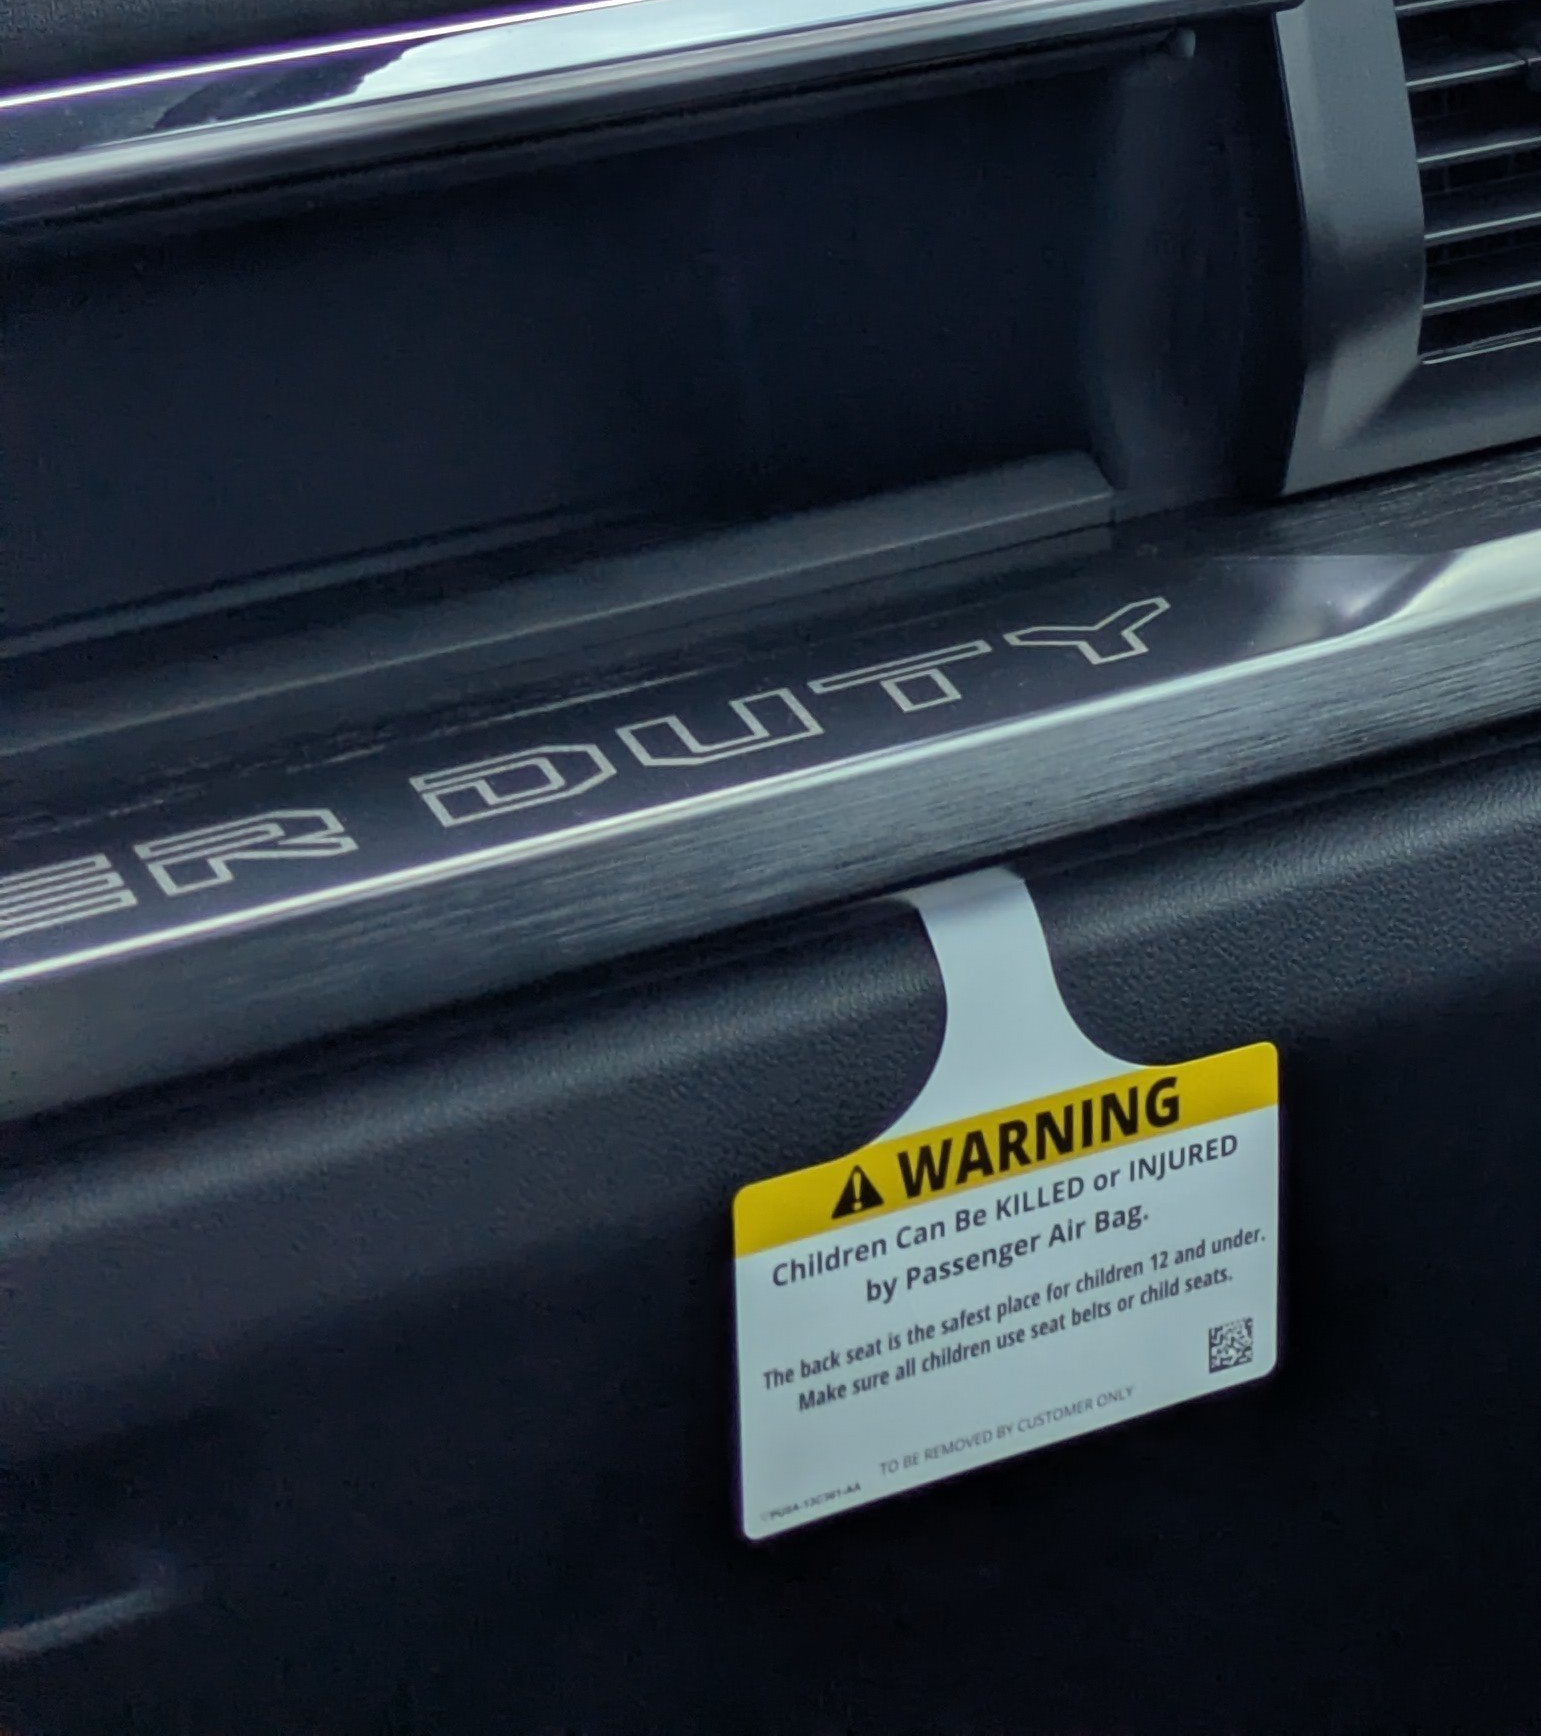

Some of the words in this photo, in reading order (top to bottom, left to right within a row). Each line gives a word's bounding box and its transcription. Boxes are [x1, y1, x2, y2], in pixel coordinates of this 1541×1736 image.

[408, 597, 1170, 827] DUTY
[897, 1076, 1180, 1199] WARNING
[772, 1238, 887, 1287] Children
[896, 1220, 945, 1249] Can
[955, 1208, 987, 1232] Be
[996, 1176, 1084, 1220] KILLED
[1093, 1169, 1120, 1192] or
[1129, 1134, 1238, 1181] INJURED
[866, 1277, 897, 1304] by
[906, 1233, 1041, 1290] Passenger
[1048, 1219, 1086, 1248] Air
[1095, 1205, 1148, 1233] Bag.
[763, 1367, 795, 1390] The
[800, 1350, 841, 1378] back
[846, 1339, 881, 1365] seat
[888, 1332, 901, 1351] is
[907, 1324, 936, 1346] the
[941, 1304, 991, 1335] safest
[997, 1290, 1040, 1323] place
[1046, 1282, 1071, 1303] for
[1076, 1260, 1144, 1294] children
[1150, 1250, 1169, 1271] 12
[1174, 1239, 1206, 1265] and
[1211, 1228, 1266, 1254] under.
[799, 1383, 847, 1412] Make
[852, 1370, 890, 1395] sure
[895, 1357, 916, 1381] all
[921, 1338, 991, 1373] children
[996, 1328, 1025, 1350] use
[1031, 1314, 1065, 1339] seat
[1070, 1302, 1112, 1326] belts
[1116, 1294, 1135, 1312] or
[1140, 1277, 1179, 1305] child
[1184, 1267, 1233, 1294] seats.
[880, 1460, 899, 1476] TO
[903, 1452, 920, 1469] BE
[924, 1429, 993, 1461] REMOVED
[996, 1422, 1015, 1440] BY
[1017, 1397, 1094, 1433] CUSTOMER
[1096, 1384, 1136, 1407] ONLY
